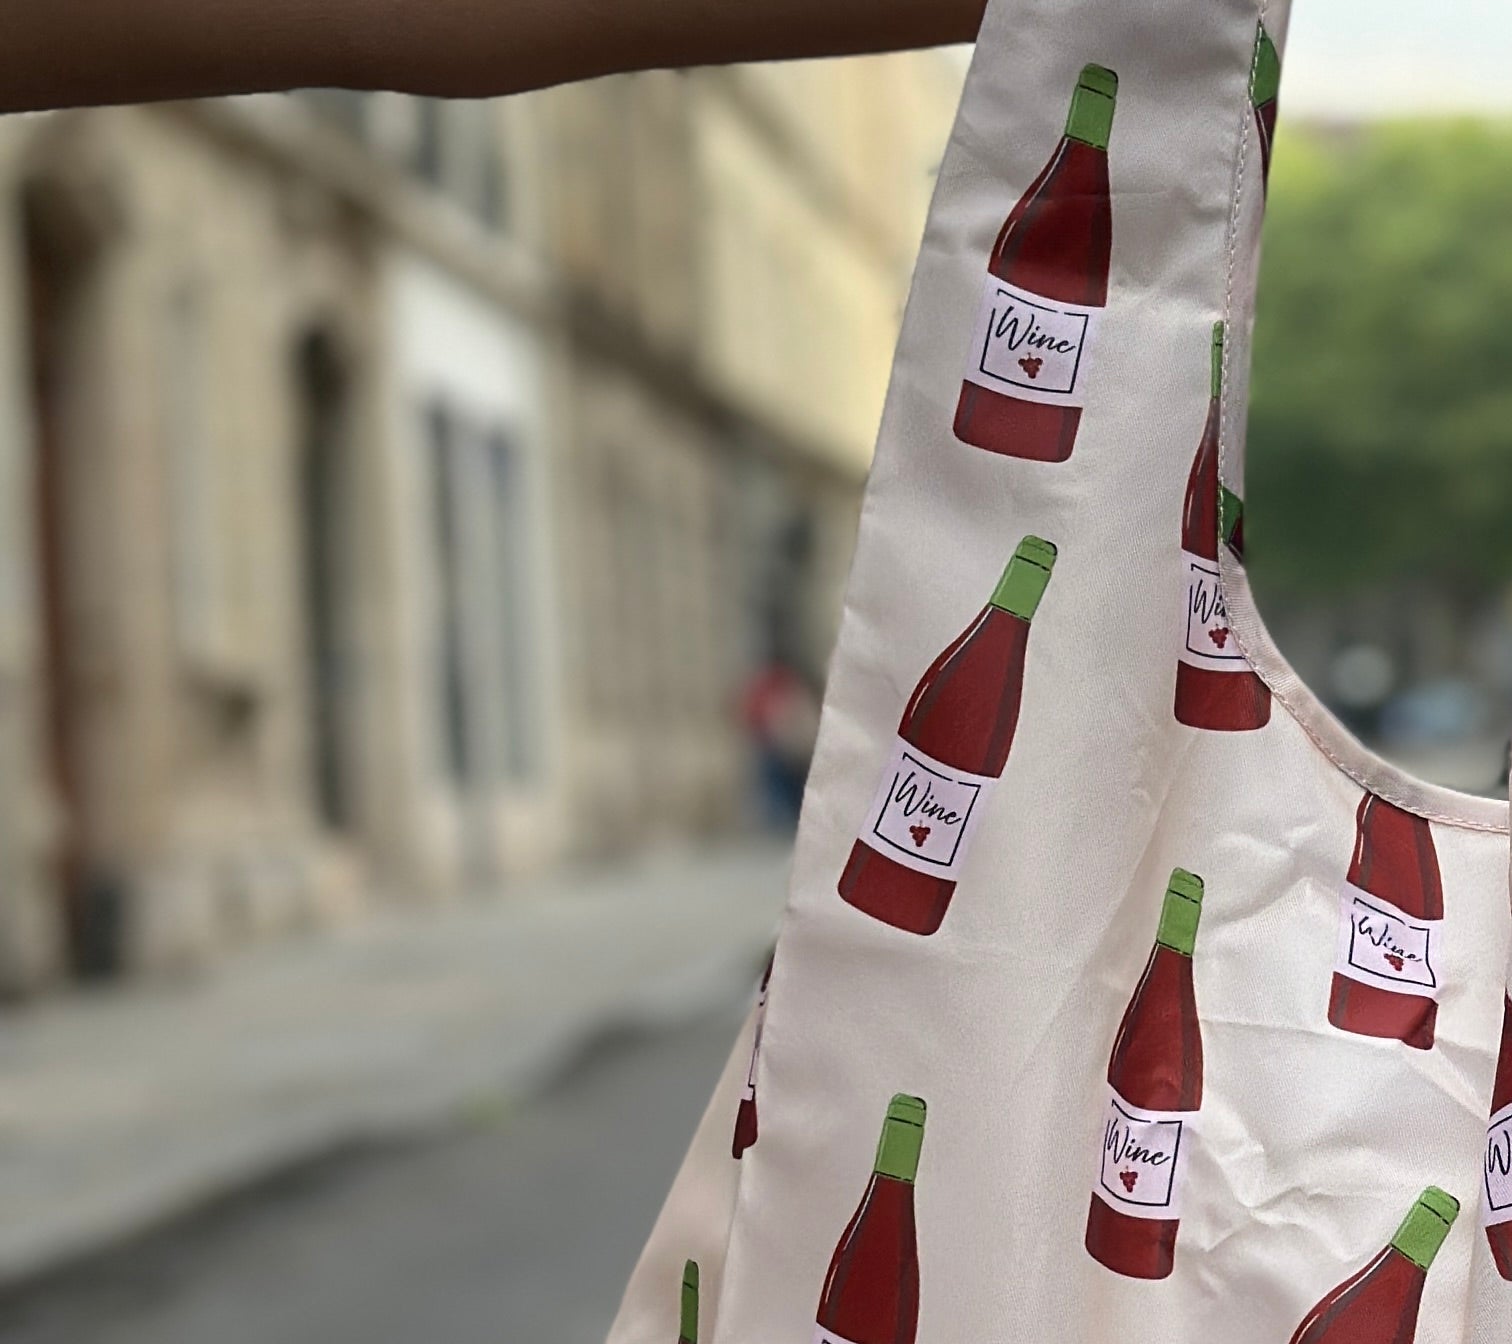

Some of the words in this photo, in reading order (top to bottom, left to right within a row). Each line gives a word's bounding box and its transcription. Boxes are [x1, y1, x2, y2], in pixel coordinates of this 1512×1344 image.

[996, 305, 1077, 353] Wine
[897, 770, 961, 825] Wine
[1106, 1118, 1170, 1166] Wine
